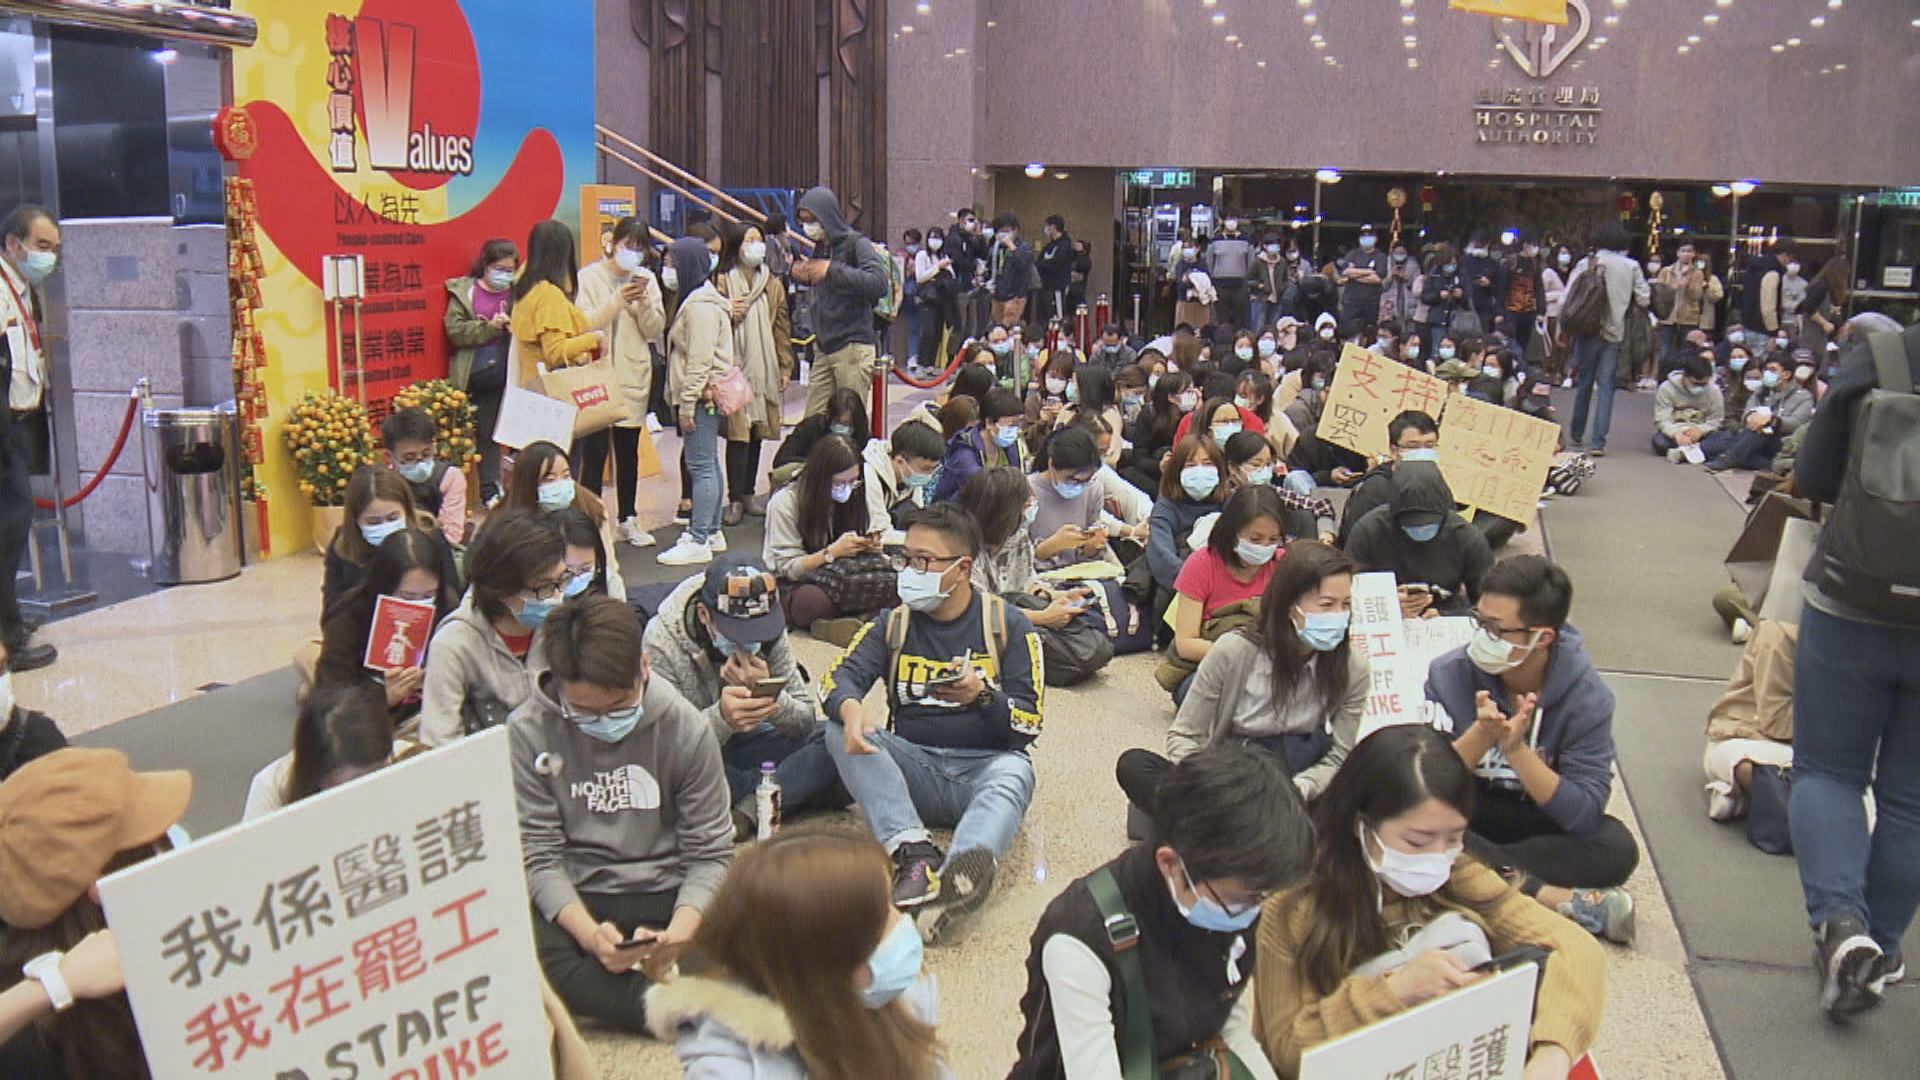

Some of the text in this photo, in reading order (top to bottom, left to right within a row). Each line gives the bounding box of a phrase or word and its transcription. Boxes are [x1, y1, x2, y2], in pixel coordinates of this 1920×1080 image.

[354, 16, 474, 175] Values
[1476, 112, 1598, 128] HOSPITAL
[1476, 130, 1598, 144] AUTHORITY
[1163, 172, 1191, 186] 出口
[1349, 354, 1441, 413] 支持
[570, 779, 629, 800] NORTH
[594, 766, 628, 785] THE
[587, 793, 632, 813] FACE
[161, 800, 487, 988] 我係醫護
[184, 889, 499, 1073] 我在罷工
[325, 975, 490, 1080] STAFF
[387, 1022, 510, 1080] IKE
